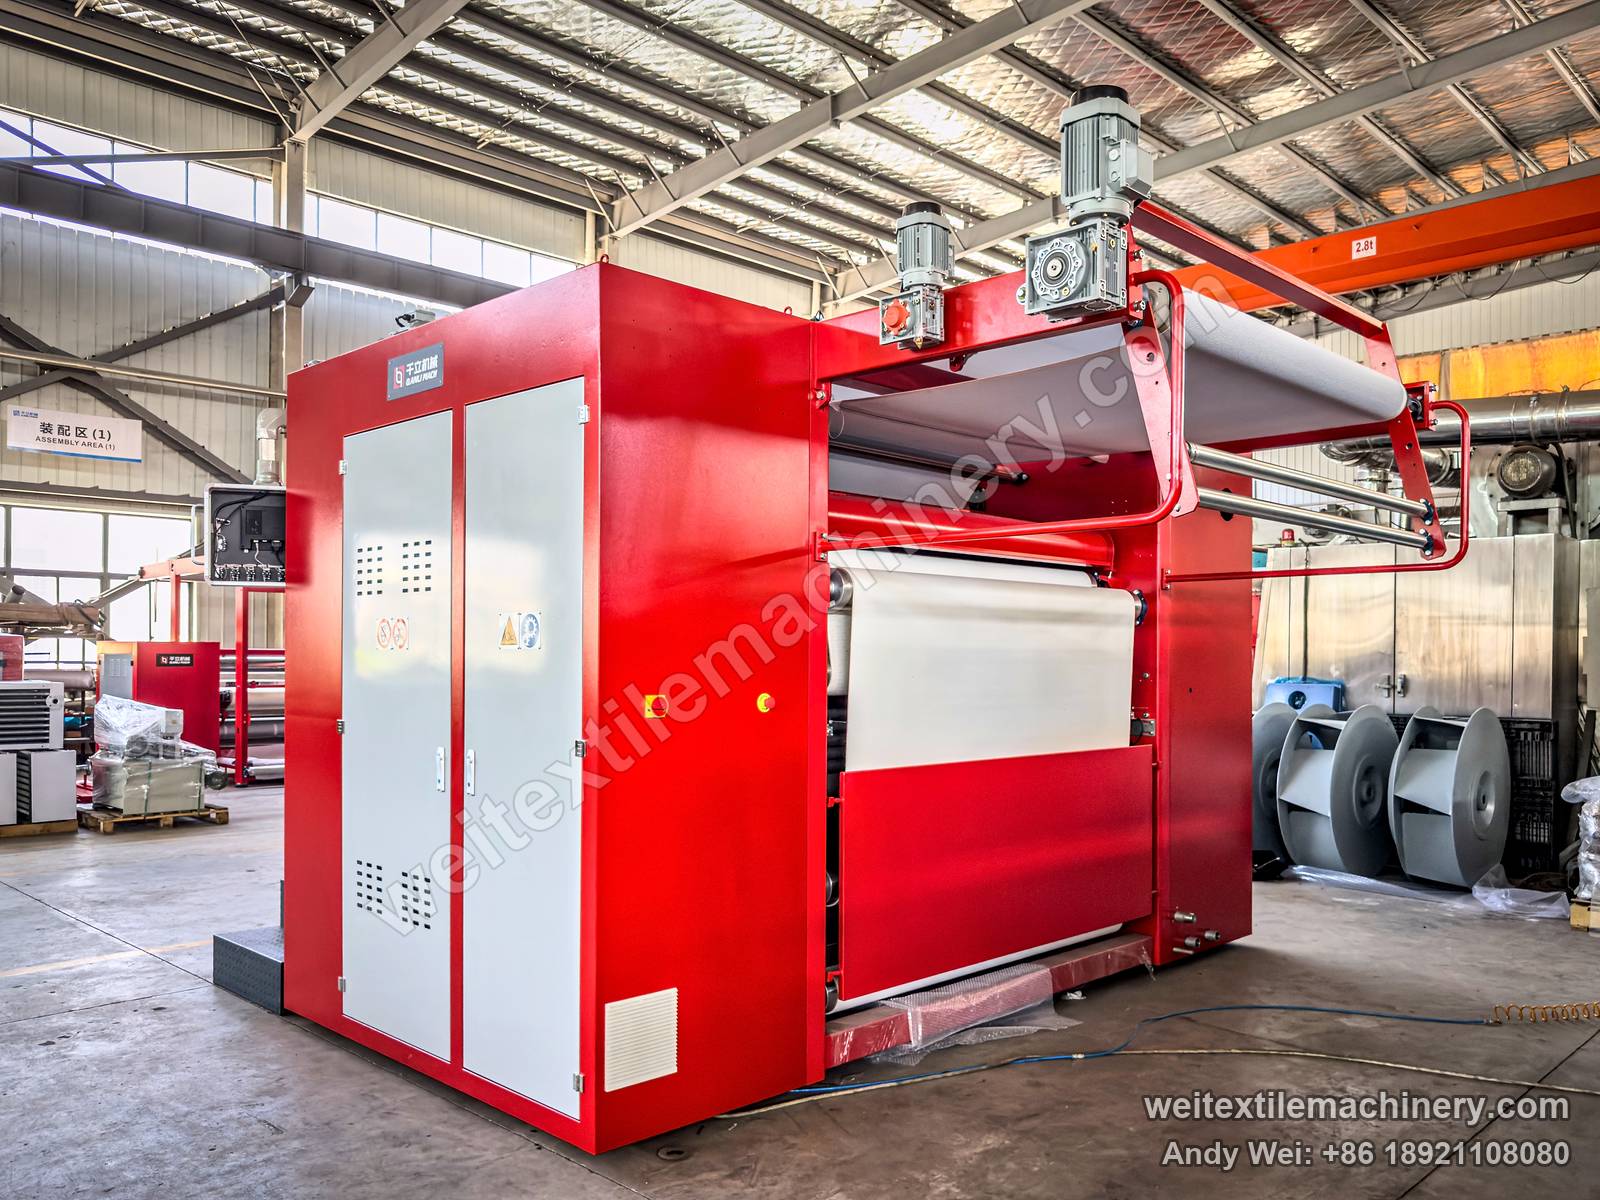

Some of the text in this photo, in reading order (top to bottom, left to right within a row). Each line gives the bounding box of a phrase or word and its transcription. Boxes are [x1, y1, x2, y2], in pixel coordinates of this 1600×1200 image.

[1356, 240, 1373, 252] 2.8t
[406, 354, 438, 376] 千立机械
[35, 435, 116, 451] ASSEMBLY AREA (1)
